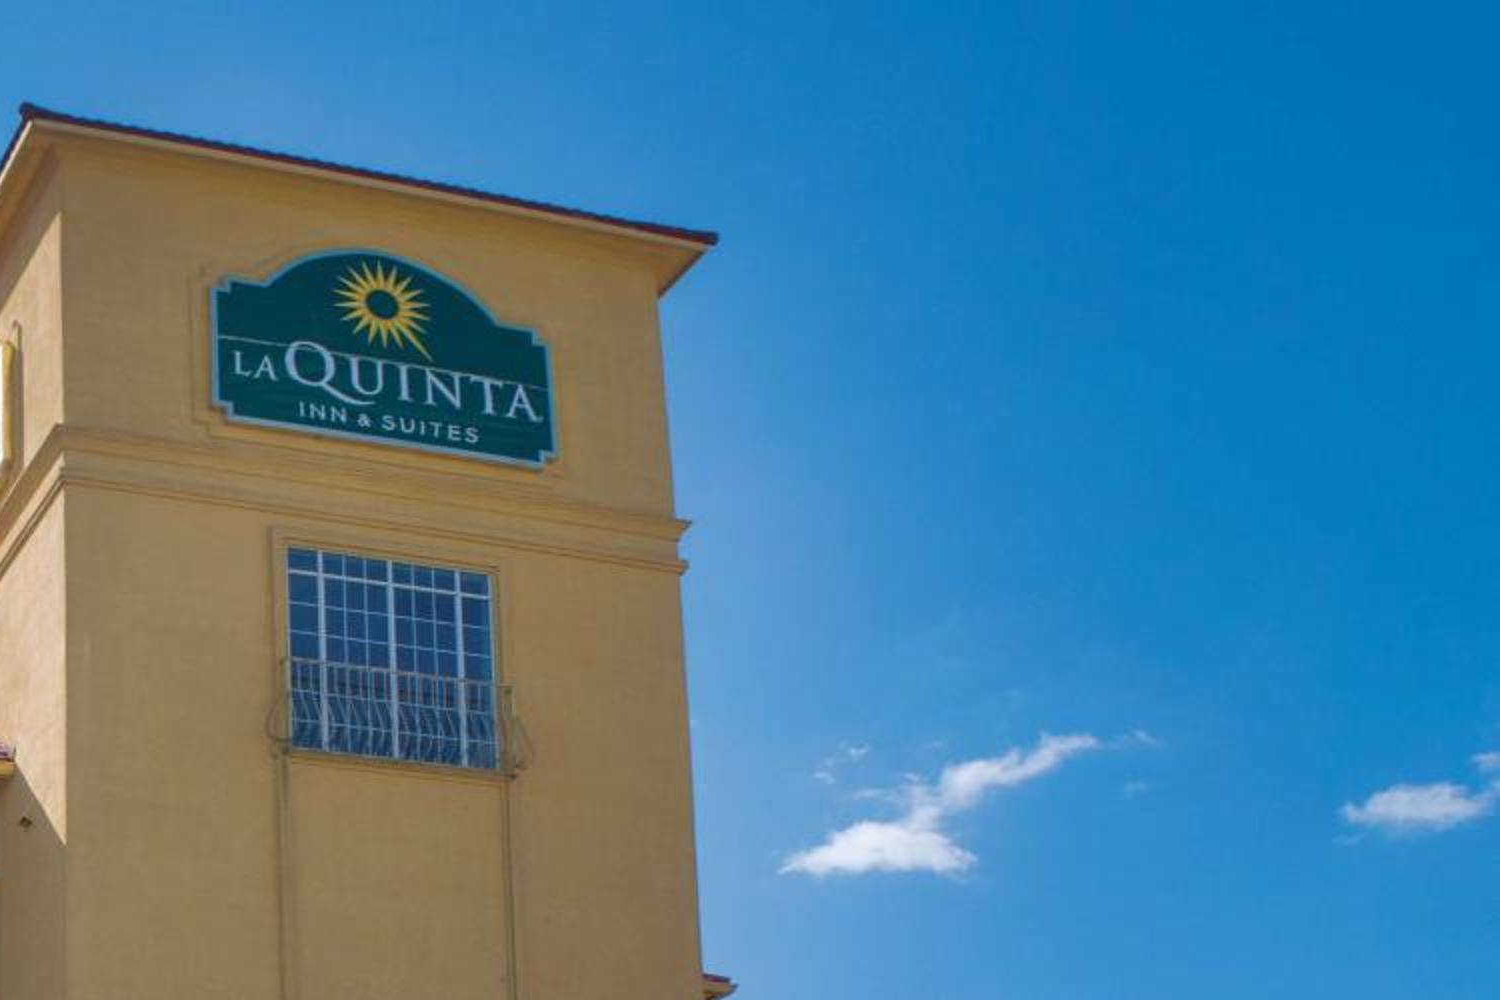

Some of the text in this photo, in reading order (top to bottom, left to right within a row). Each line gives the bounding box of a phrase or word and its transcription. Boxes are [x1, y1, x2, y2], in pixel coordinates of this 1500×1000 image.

[233, 341, 543, 422] LA QUINTA
[299, 401, 480, 443] INN & SUITES
